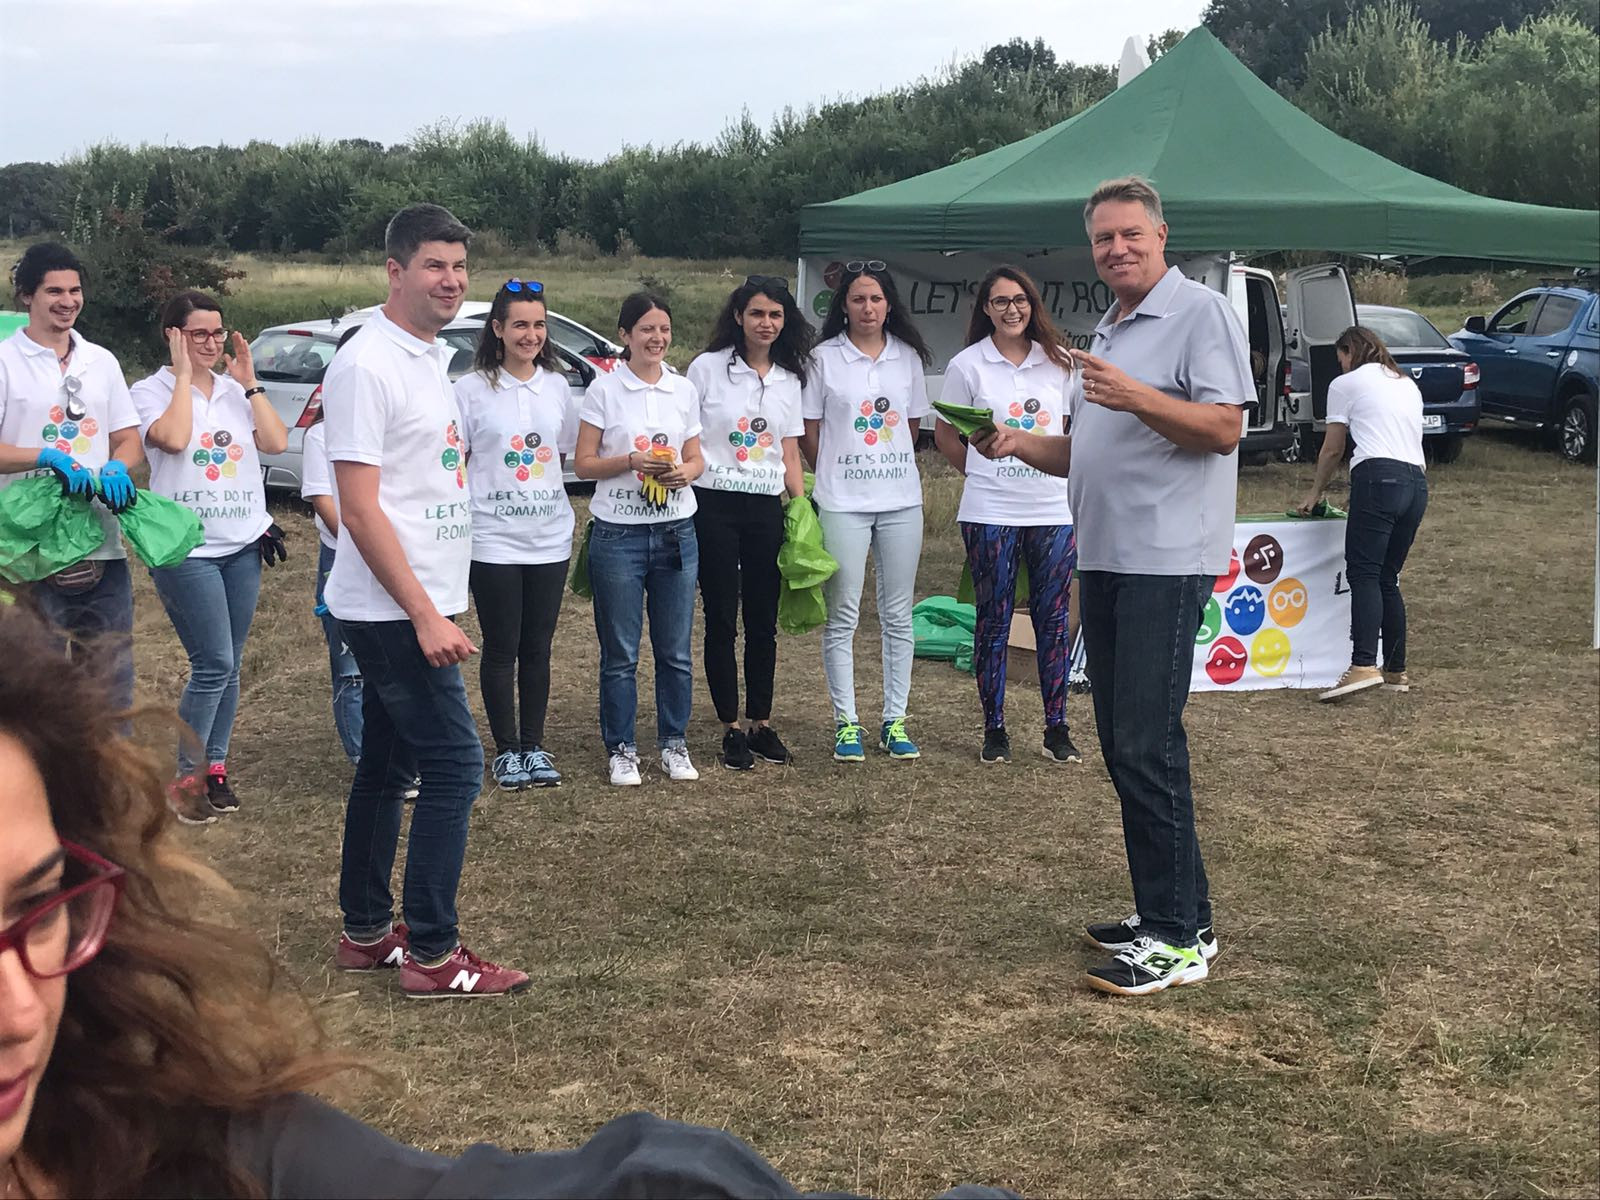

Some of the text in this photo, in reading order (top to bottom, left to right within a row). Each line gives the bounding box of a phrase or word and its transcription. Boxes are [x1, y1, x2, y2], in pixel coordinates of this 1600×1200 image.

[837, 453, 876, 465] LET'S
[880, 452, 897, 464] DO
[752, 467, 767, 479] DO
[173, 490, 219, 502] LET'S
[223, 490, 240, 502] DO
[487, 490, 529, 501] LET'S
[533, 489, 549, 501] DO
[188, 506, 252, 519] OMANIA!
